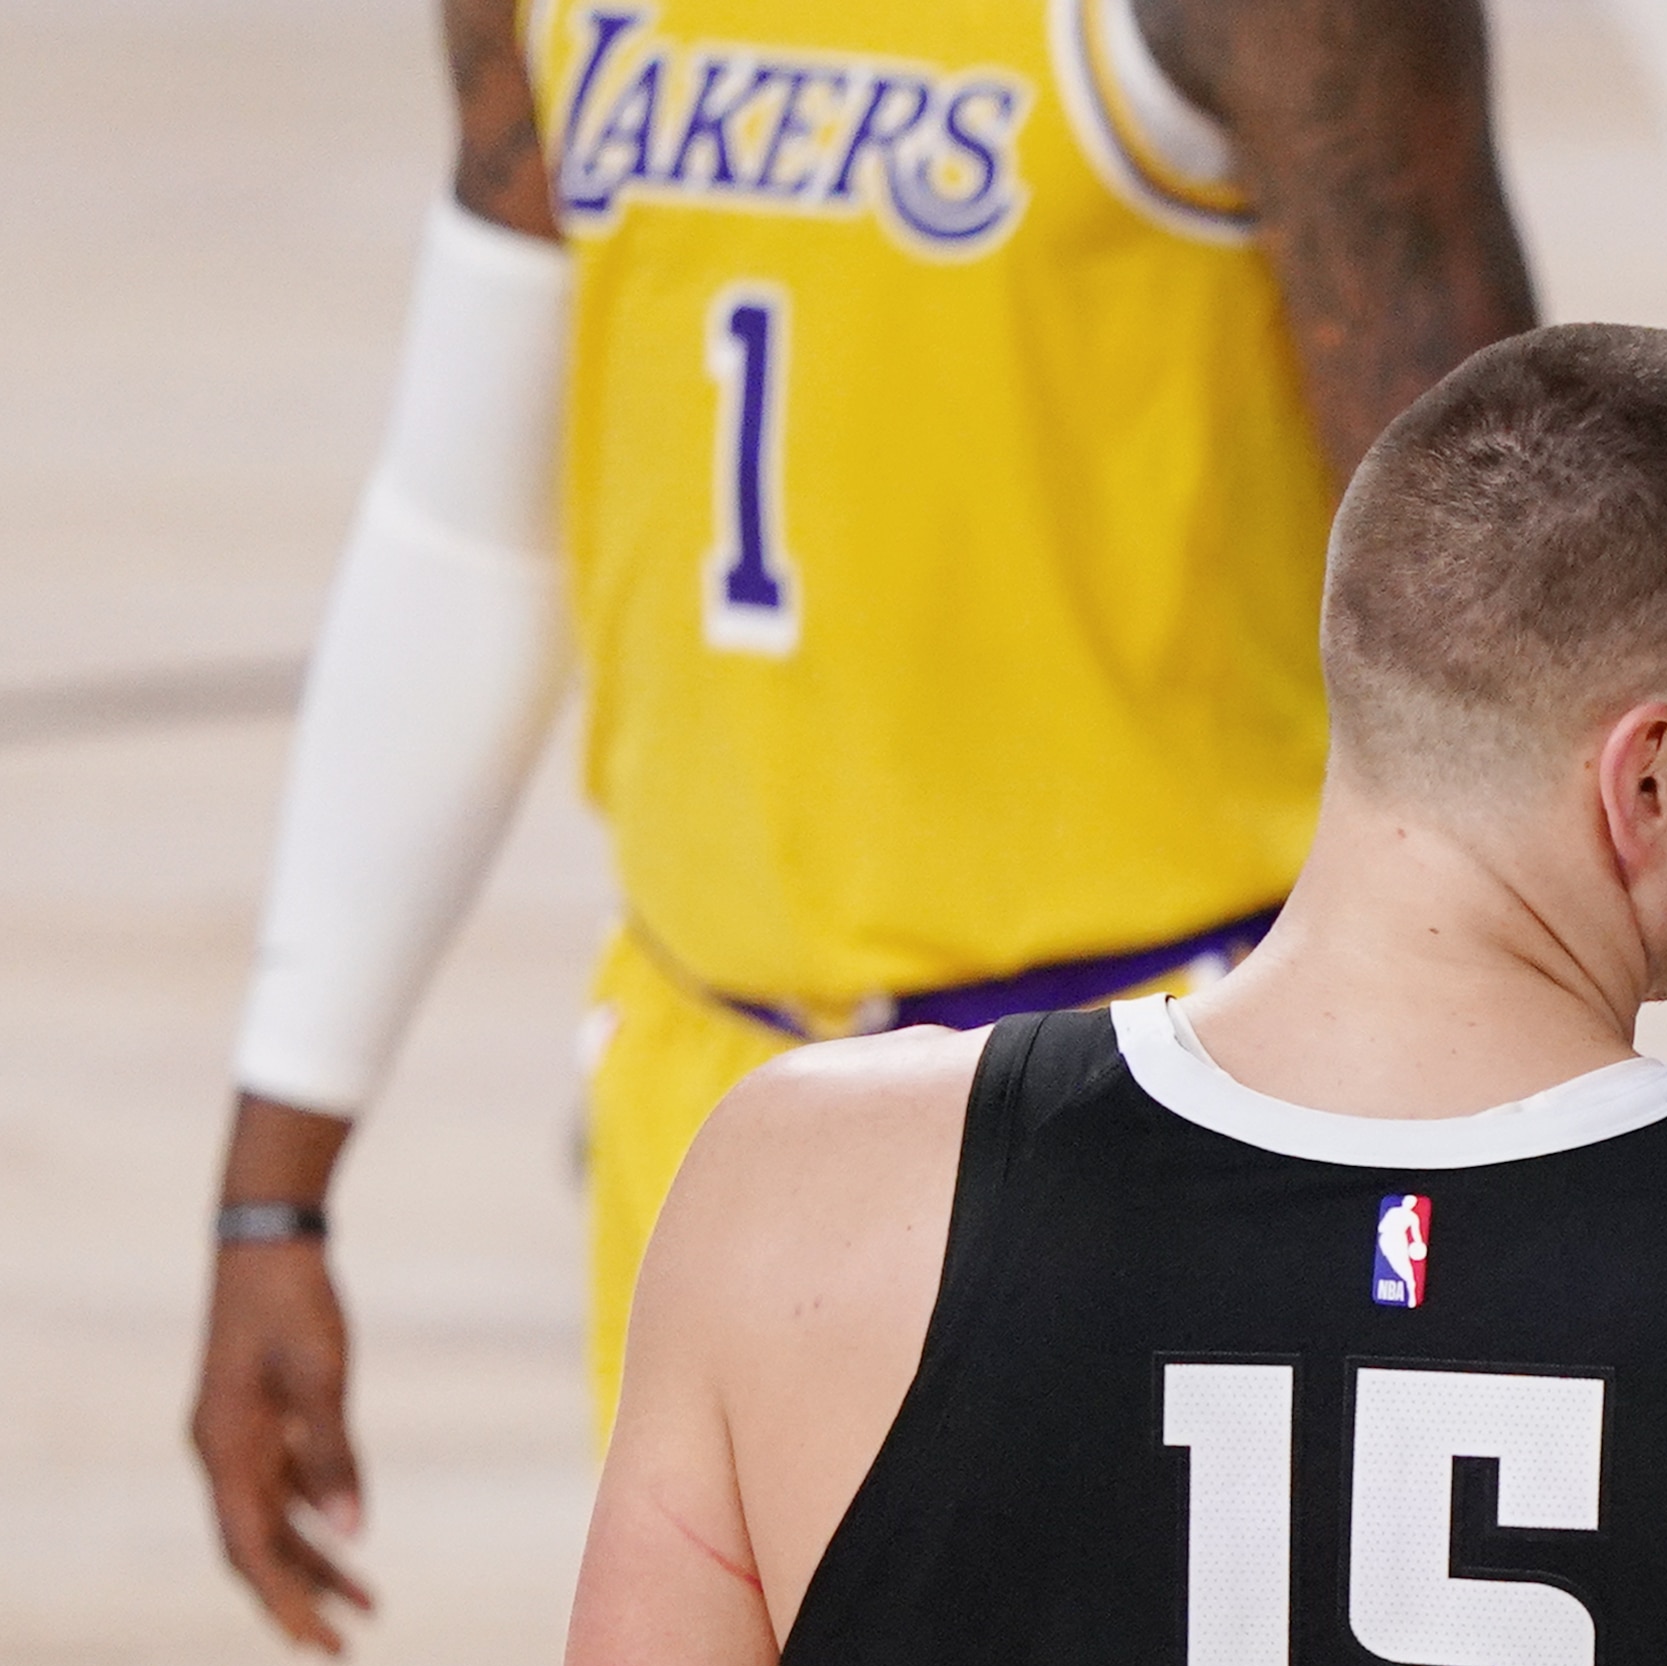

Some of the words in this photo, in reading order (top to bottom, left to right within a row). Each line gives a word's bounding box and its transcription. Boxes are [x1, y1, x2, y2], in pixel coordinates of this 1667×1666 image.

[553, 3, 1036, 264] LAKERS
[703, 278, 800, 659] 1
[1377, 1279, 1405, 1302] NBA
